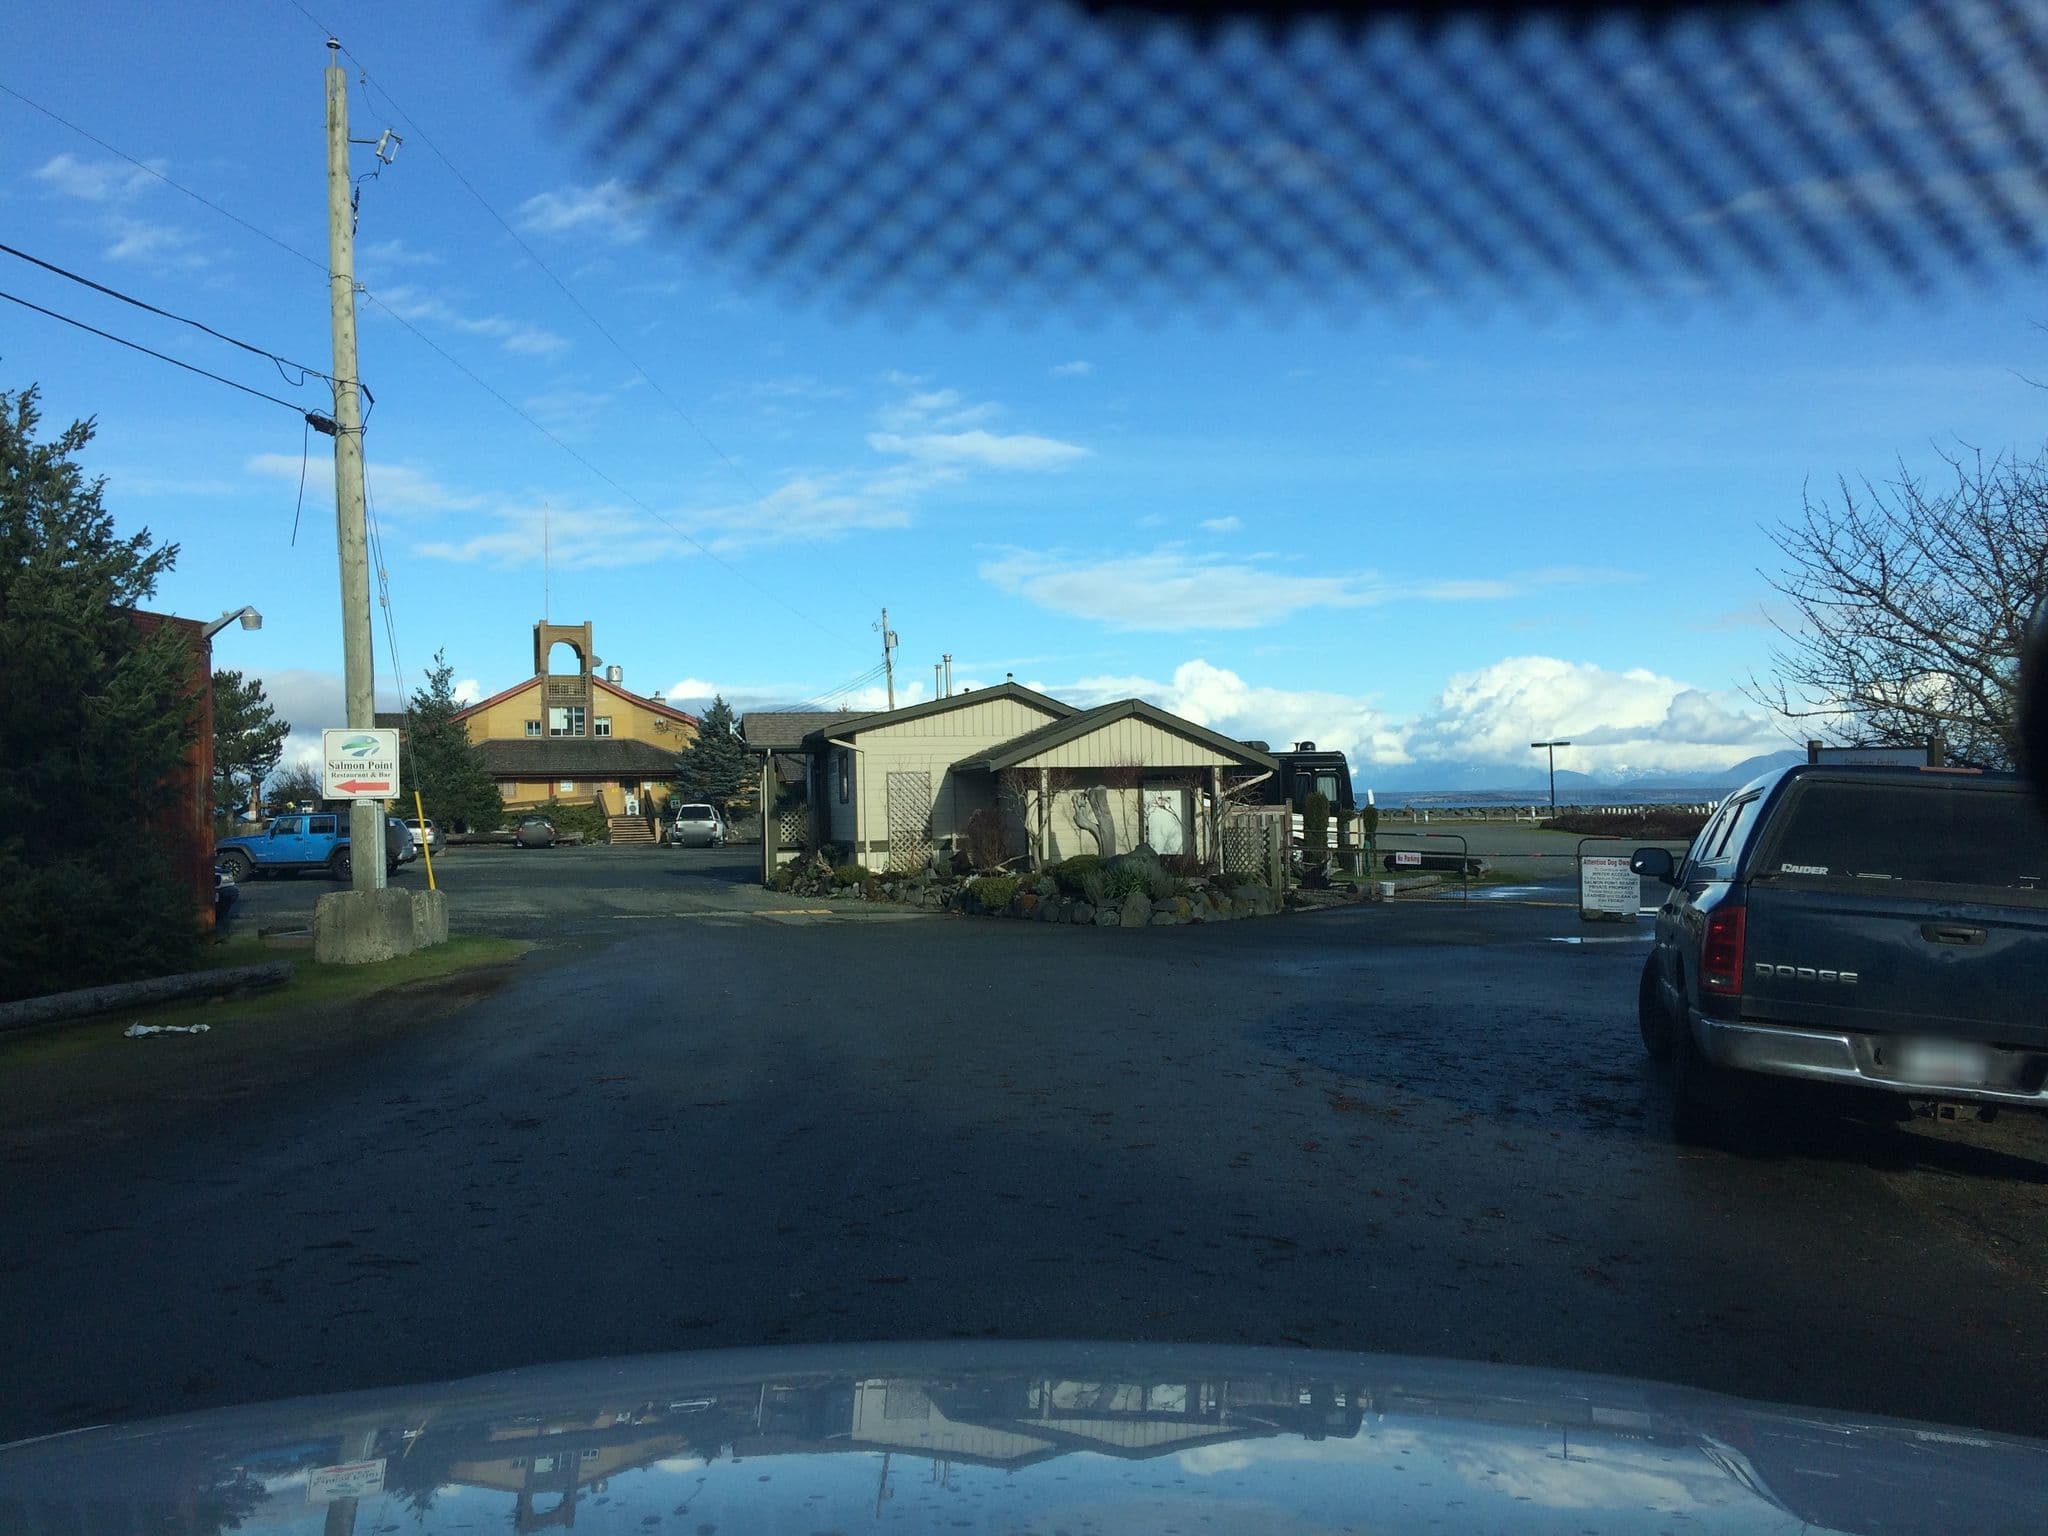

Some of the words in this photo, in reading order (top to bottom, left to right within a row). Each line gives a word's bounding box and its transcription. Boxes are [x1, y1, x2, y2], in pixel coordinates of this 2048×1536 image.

[328, 761, 364, 770] Salmon
[368, 761, 392, 770] Point
[1404, 854, 1420, 862] Parking
[1608, 858, 1617, 867] Dog
[1781, 863, 1828, 876] RAIDER
[1755, 962, 1858, 984] DODGE
